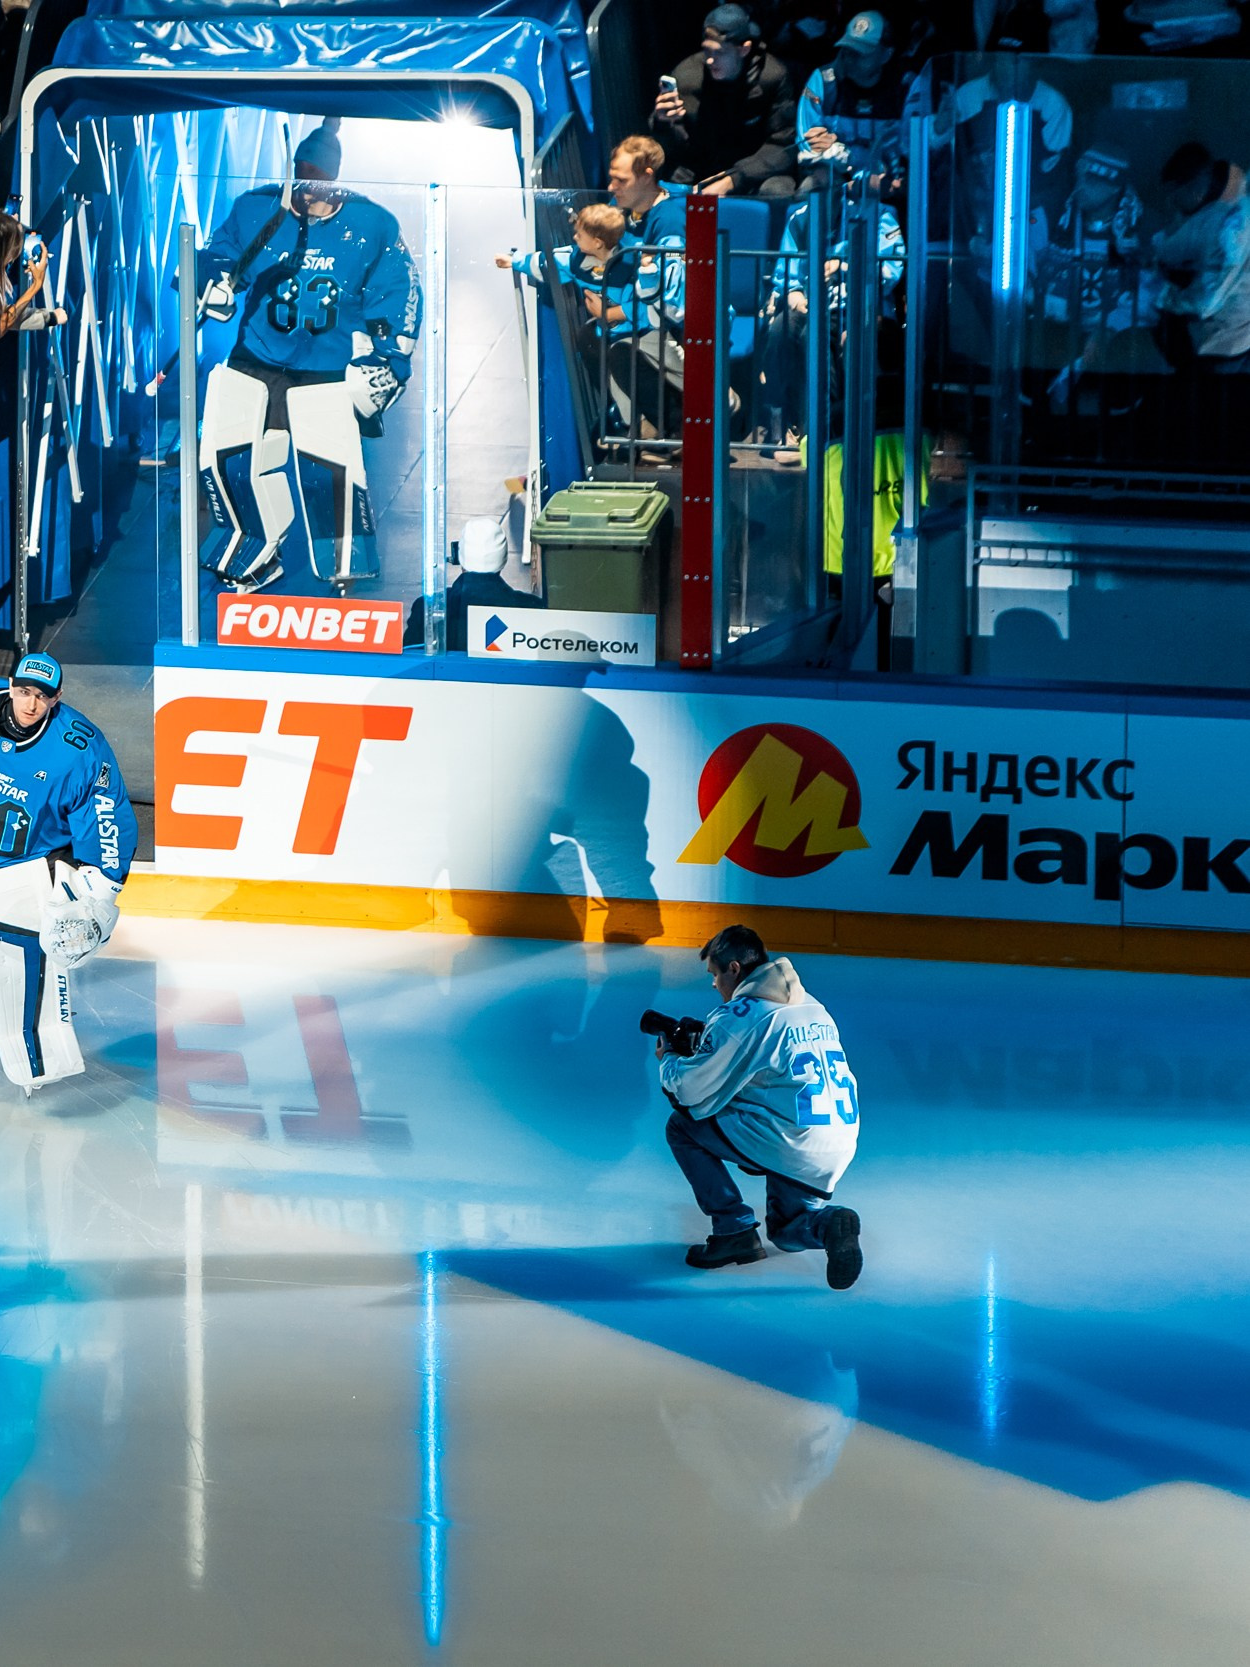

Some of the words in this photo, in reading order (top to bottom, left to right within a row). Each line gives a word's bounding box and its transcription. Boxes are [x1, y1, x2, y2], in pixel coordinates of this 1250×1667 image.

[267, 273, 341, 336] 83
[220, 603, 399, 644] FONBET
[512, 632, 639, 654] Ростелеком
[63, 719, 95, 751] 60
[896, 740, 1136, 804] Яндекс
[791, 1051, 860, 1127] 25
